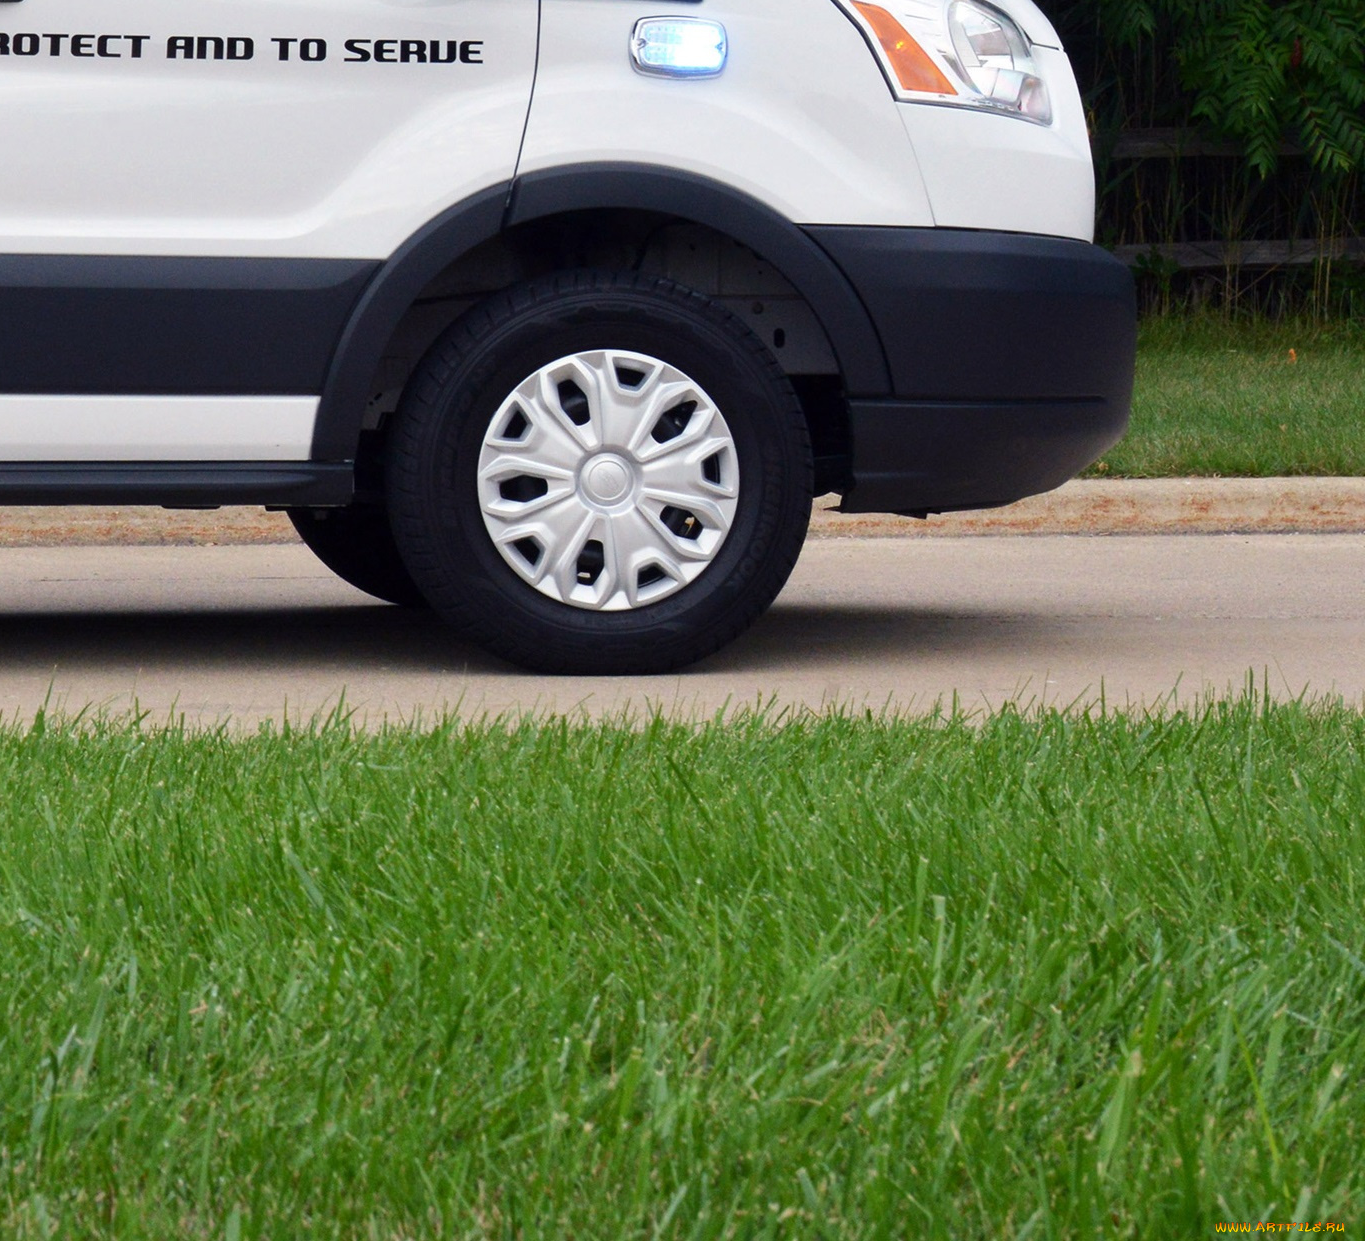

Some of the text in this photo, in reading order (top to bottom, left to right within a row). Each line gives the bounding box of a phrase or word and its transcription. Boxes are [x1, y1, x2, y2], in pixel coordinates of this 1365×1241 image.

[166, 36, 254, 61] AND
[270, 37, 327, 62] TO
[343, 39, 485, 64] SERVE
